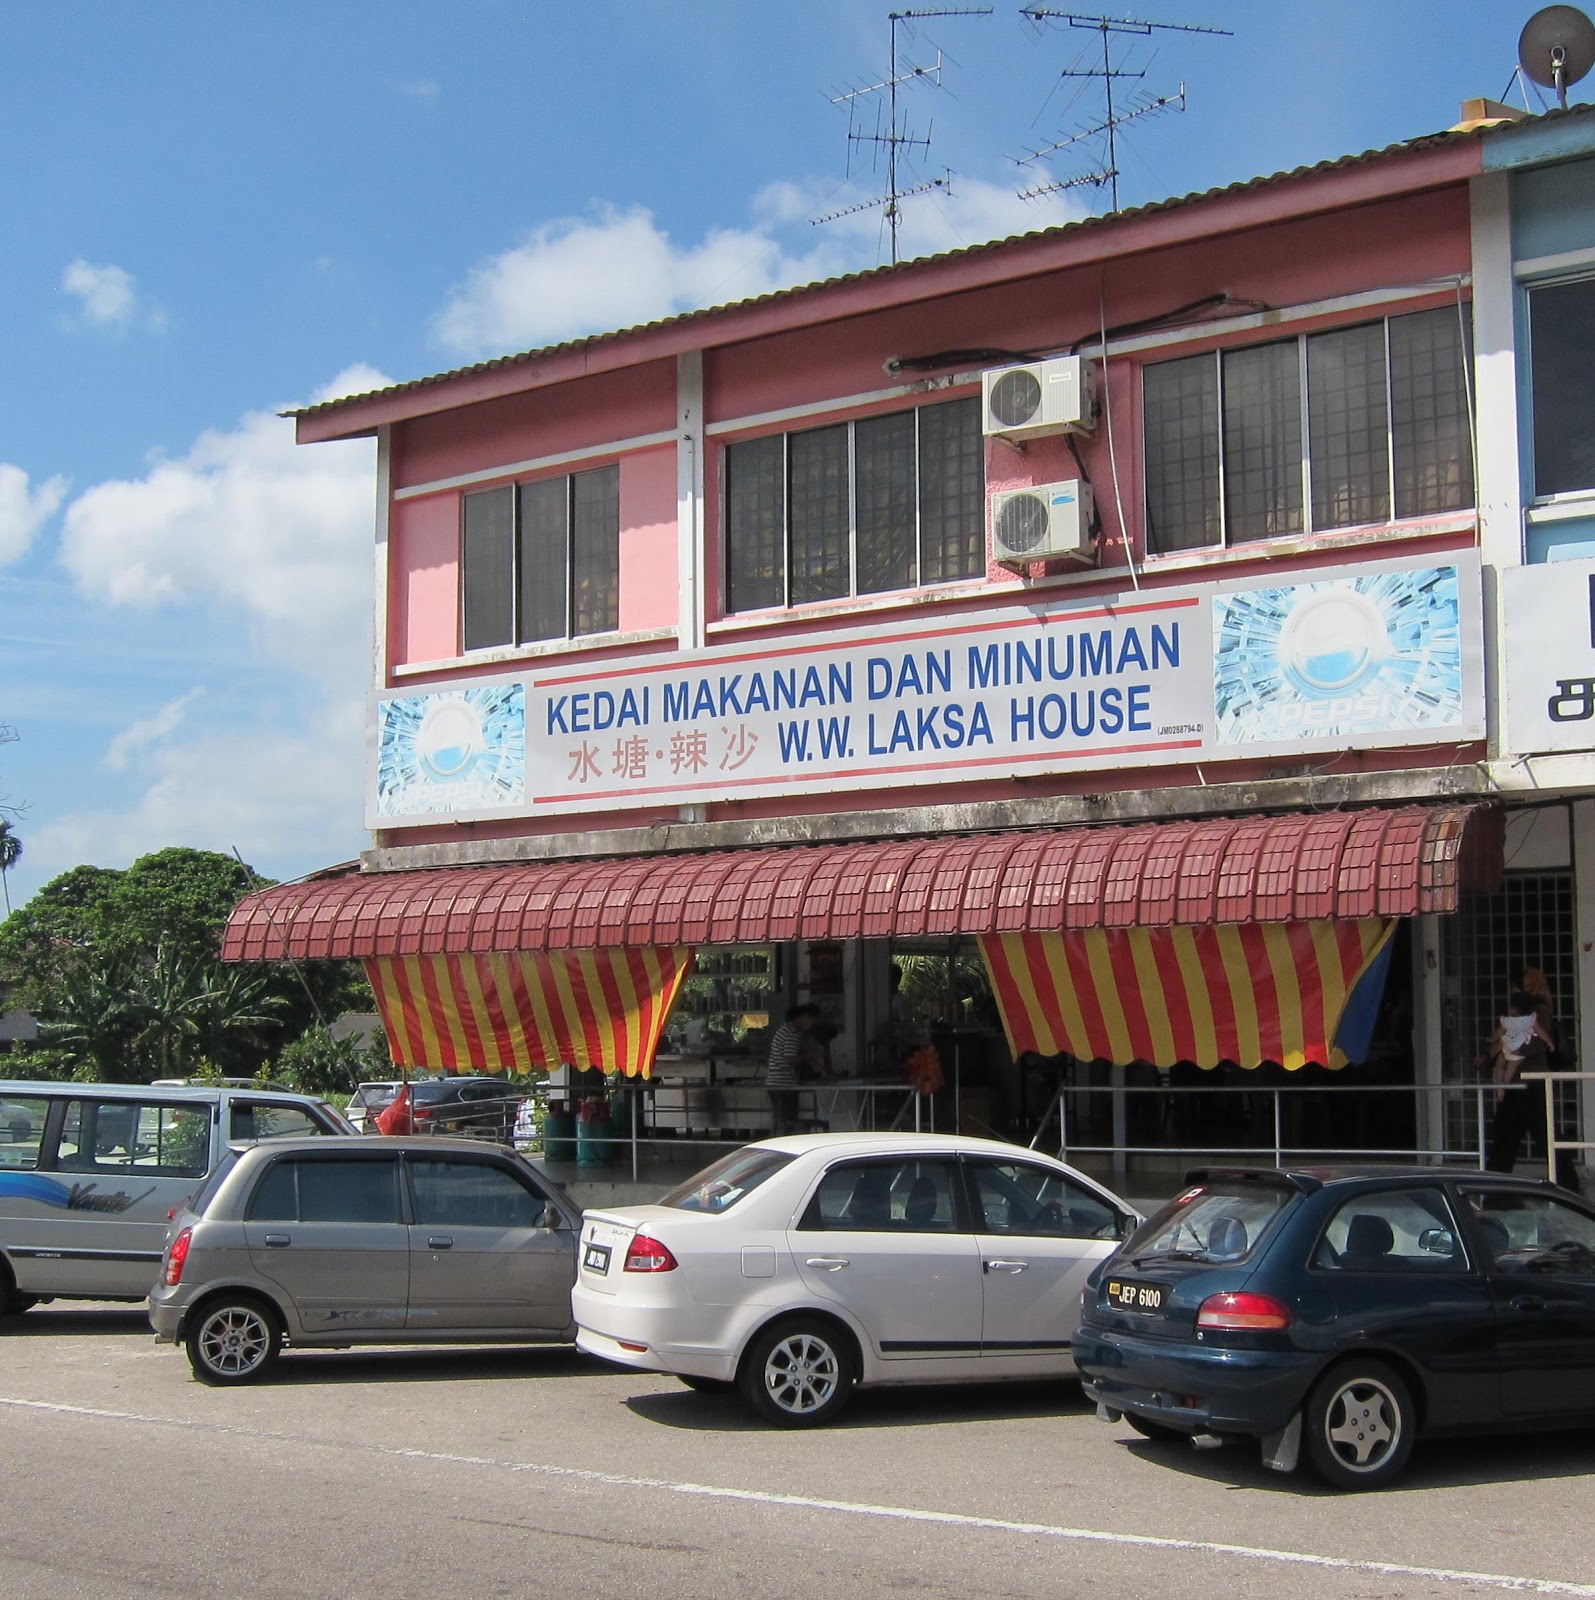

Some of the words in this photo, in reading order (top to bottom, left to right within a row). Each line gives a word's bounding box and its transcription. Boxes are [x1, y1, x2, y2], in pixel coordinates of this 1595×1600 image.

[547, 685, 650, 736] KEDAI
[662, 661, 853, 722] MAKANAN
[867, 650, 951, 701] DAN
[968, 622, 1181, 690] MINUMAN
[778, 716, 855, 764] W.W.
[868, 701, 994, 756] LAKSA
[1010, 684, 1152, 742] HOUSE
[1278, 694, 1393, 727] PEPSI
[1118, 1285, 1137, 1305] JEP
[1138, 1288, 1161, 1308] 6100
